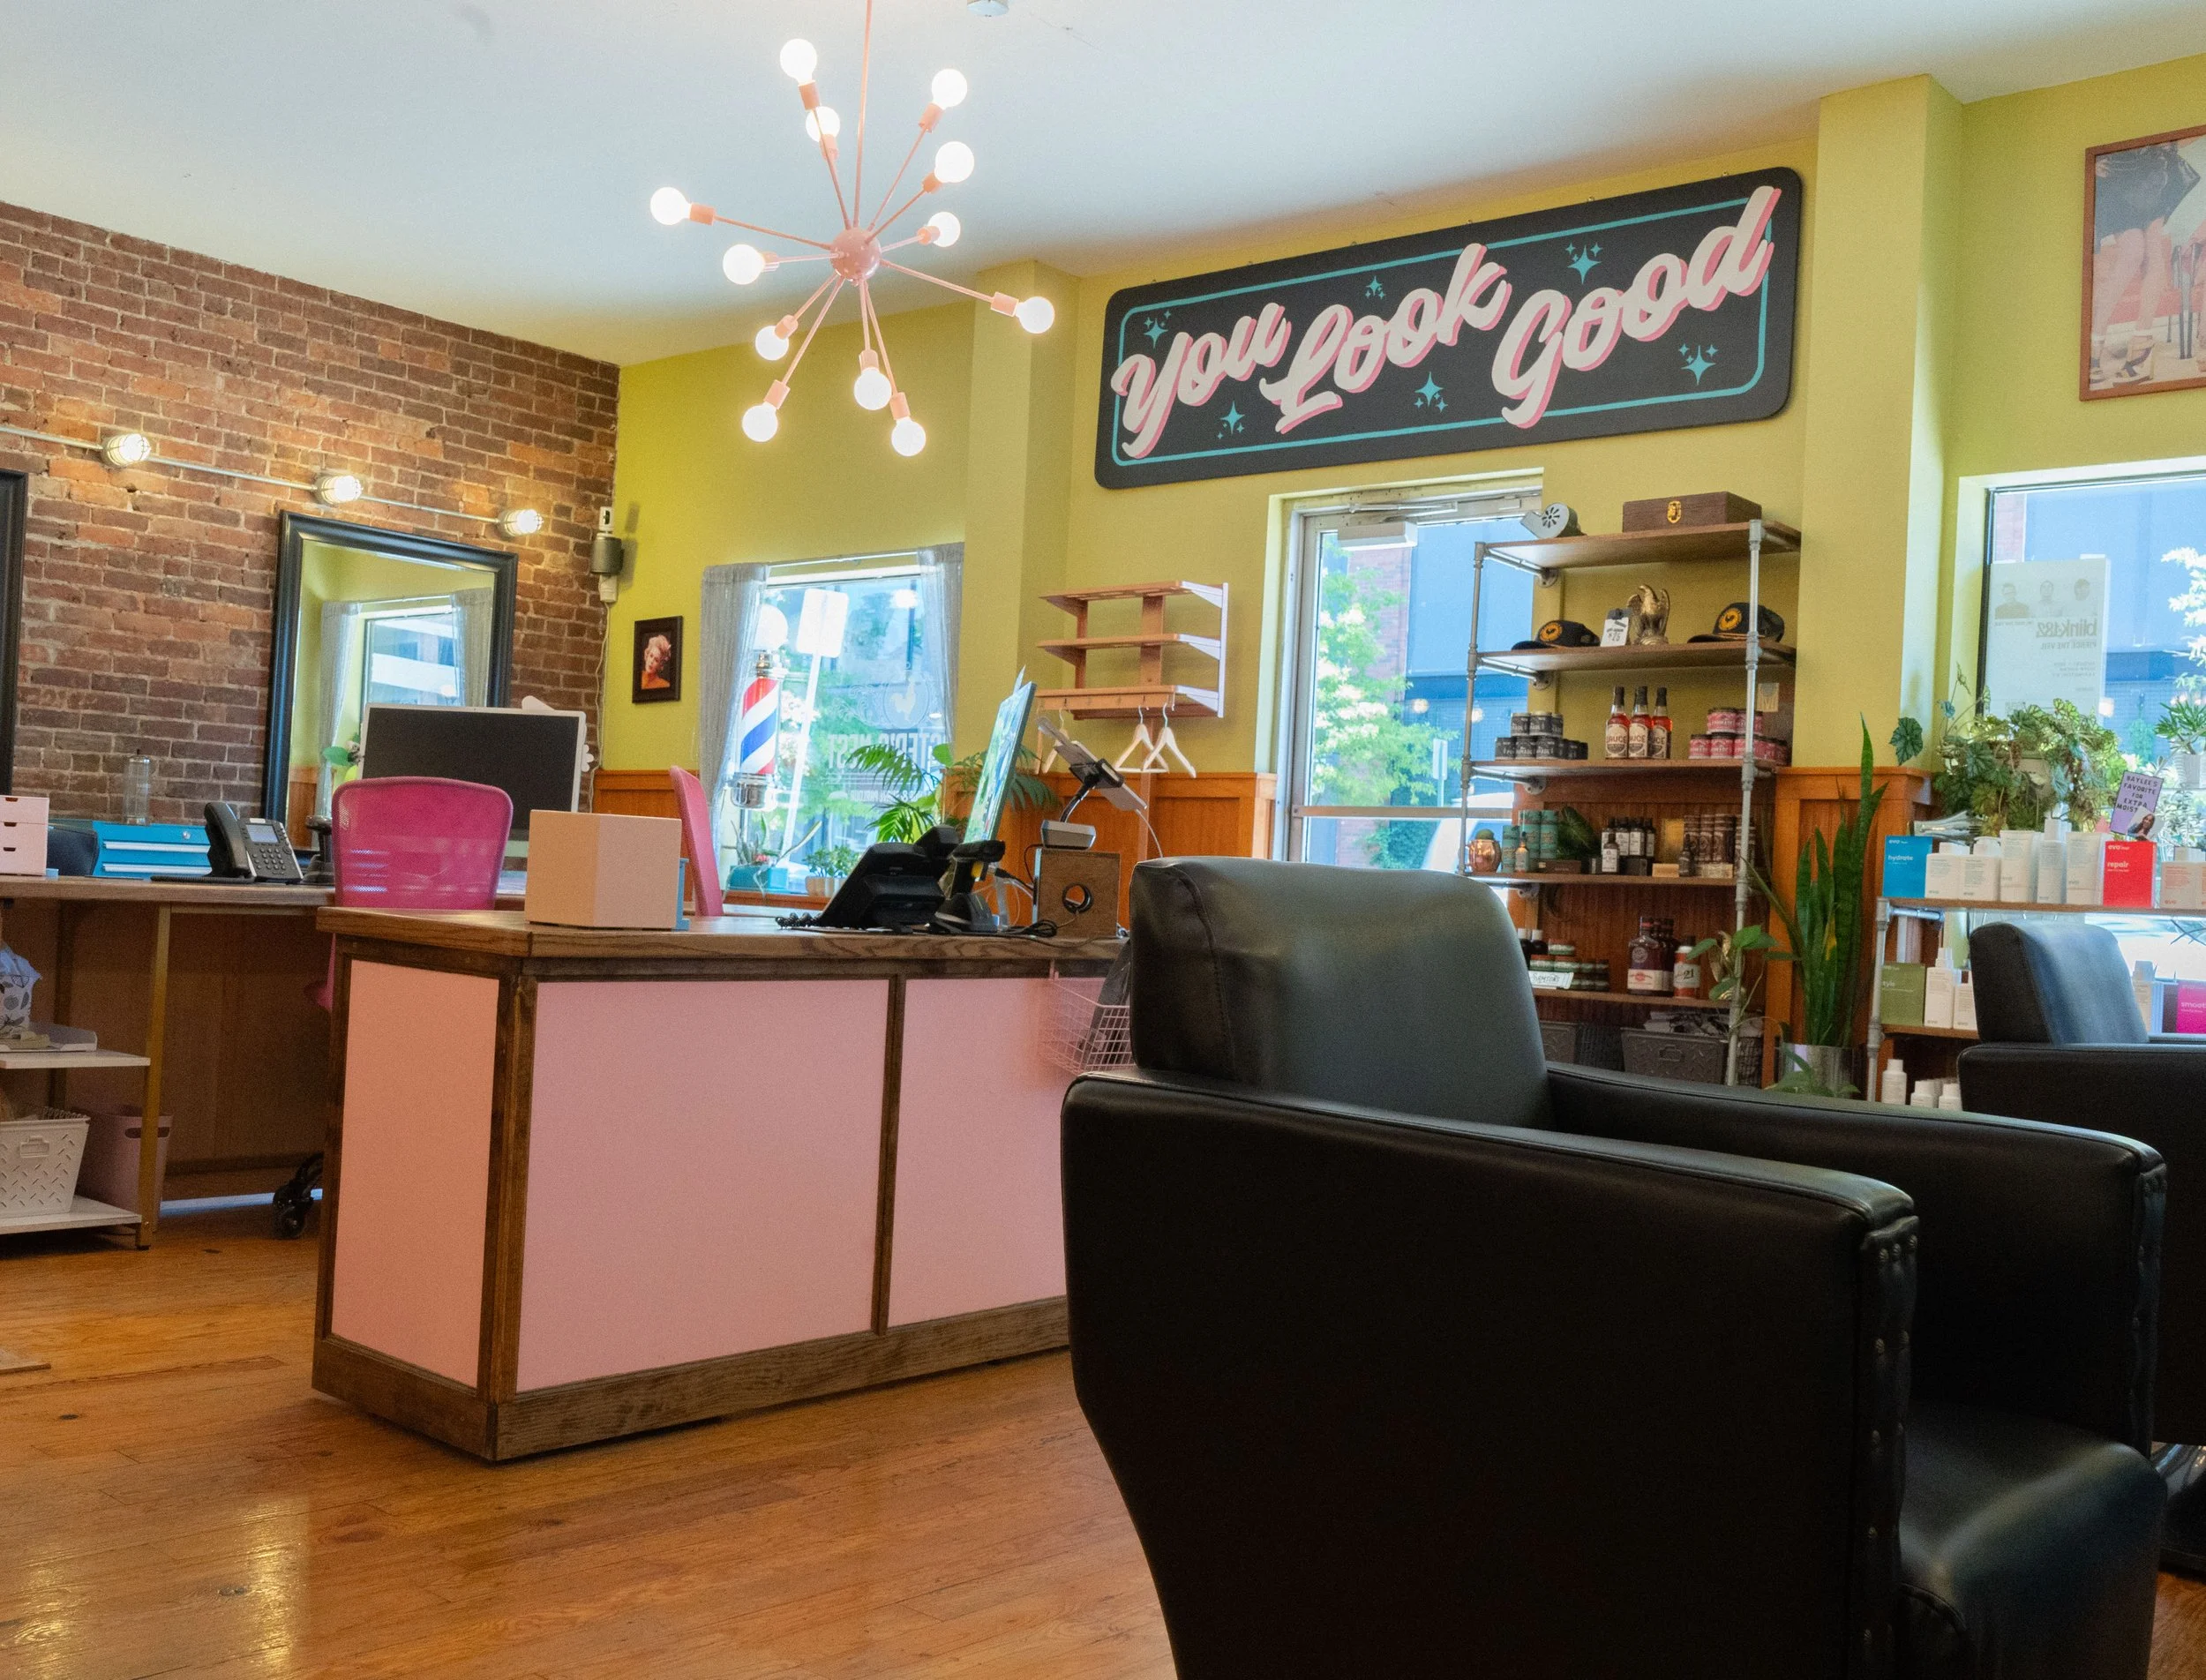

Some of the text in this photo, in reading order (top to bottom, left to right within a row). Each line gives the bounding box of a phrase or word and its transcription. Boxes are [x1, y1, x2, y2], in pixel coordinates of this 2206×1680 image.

[1111, 184, 1782, 460] You Look Good
[2123, 783, 2156, 795] FAVORITE
[2116, 803, 2139, 813] MOIST
[2123, 798, 2148, 807] EXTRA
